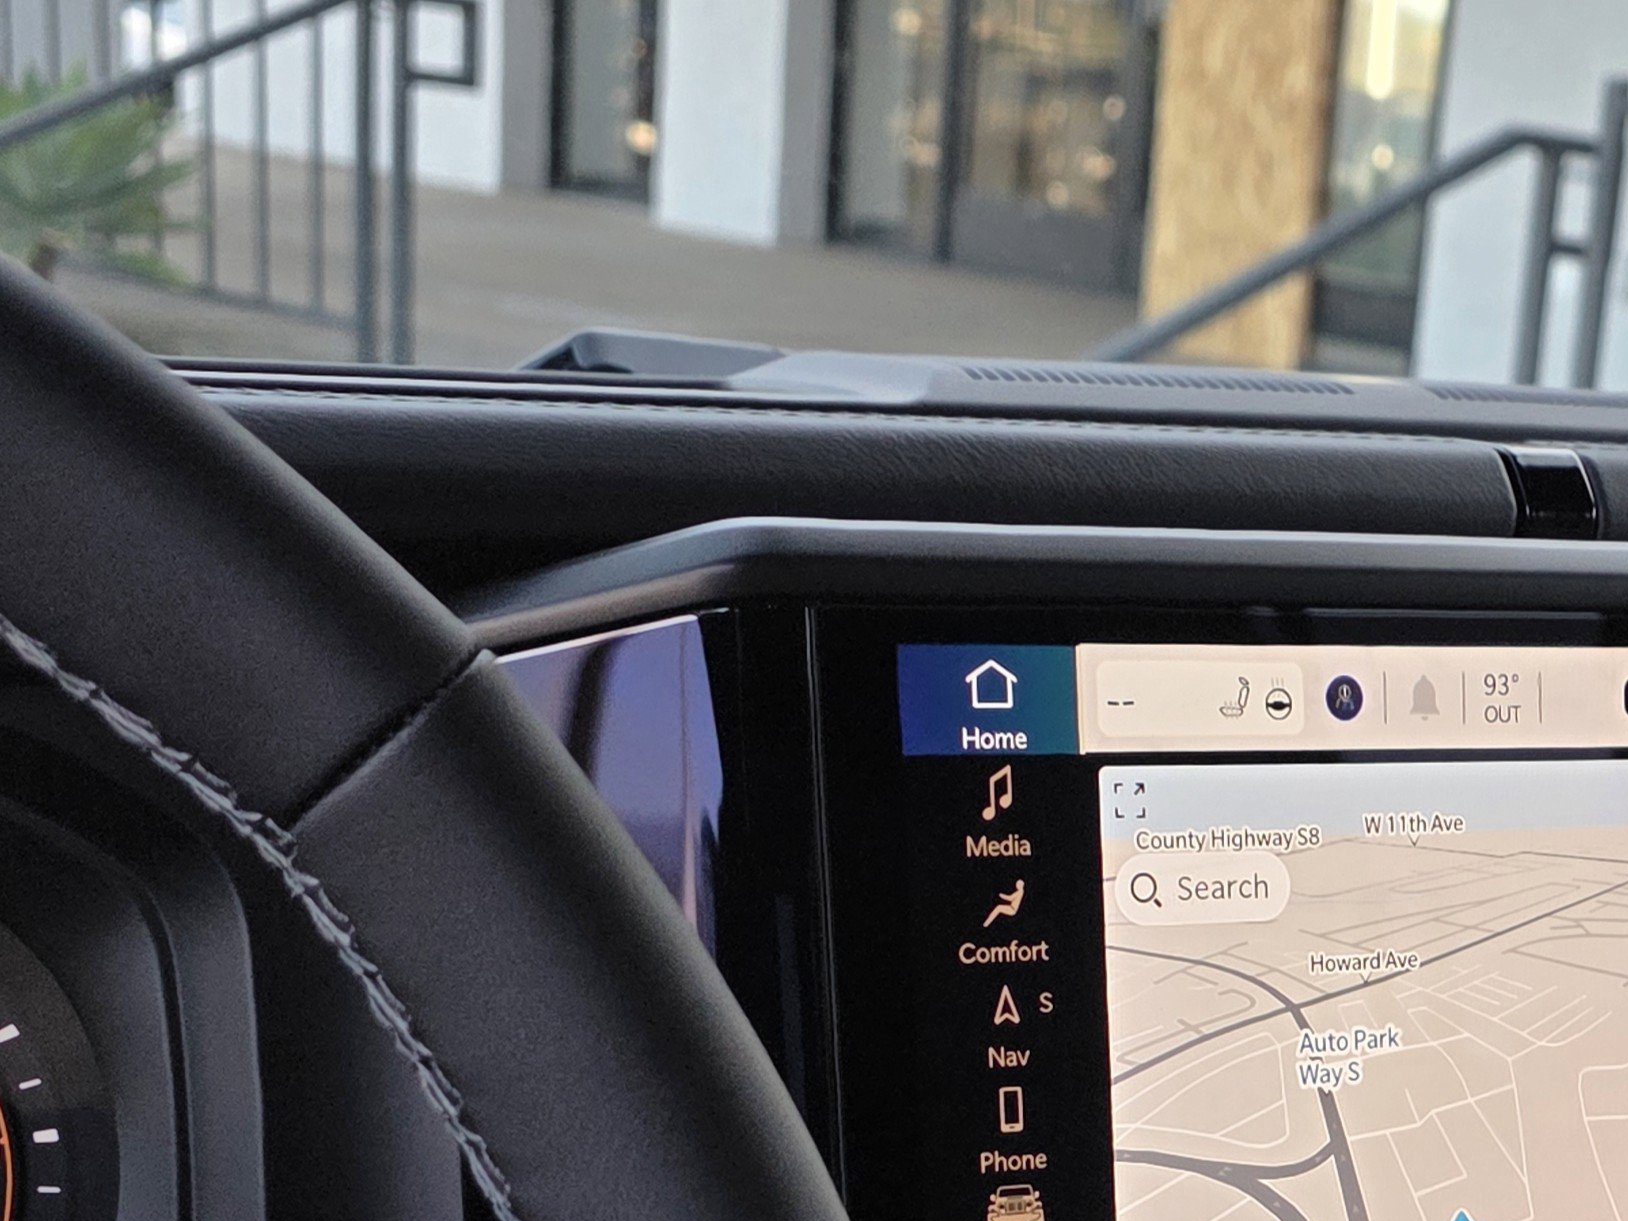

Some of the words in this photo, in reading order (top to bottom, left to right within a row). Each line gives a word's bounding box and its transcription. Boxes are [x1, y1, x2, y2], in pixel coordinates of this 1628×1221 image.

[1483, 673, 1520, 697] 93°
[1484, 705, 1521, 725] OUT
[962, 726, 1028, 750] Home
[1363, 816, 1381, 834] W
[1387, 815, 1428, 833] 11th
[1430, 815, 1464, 832] Ave
[966, 833, 1032, 857] Media
[1136, 830, 1206, 852] County
[1211, 828, 1293, 851] Highway
[1297, 827, 1320, 846] S8
[1177, 872, 1269, 900] Search
[958, 939, 1050, 964] Comfort
[1310, 952, 1381, 974] Howard
[1384, 952, 1418, 969] Ave
[1039, 991, 1054, 1013] S
[1300, 1032, 1349, 1053] Auto
[1354, 1027, 1399, 1050] Park
[988, 1046, 1031, 1068] Nav
[1299, 1063, 1343, 1088] Way
[1348, 1061, 1361, 1082] S
[980, 1150, 1048, 1174] Phone
